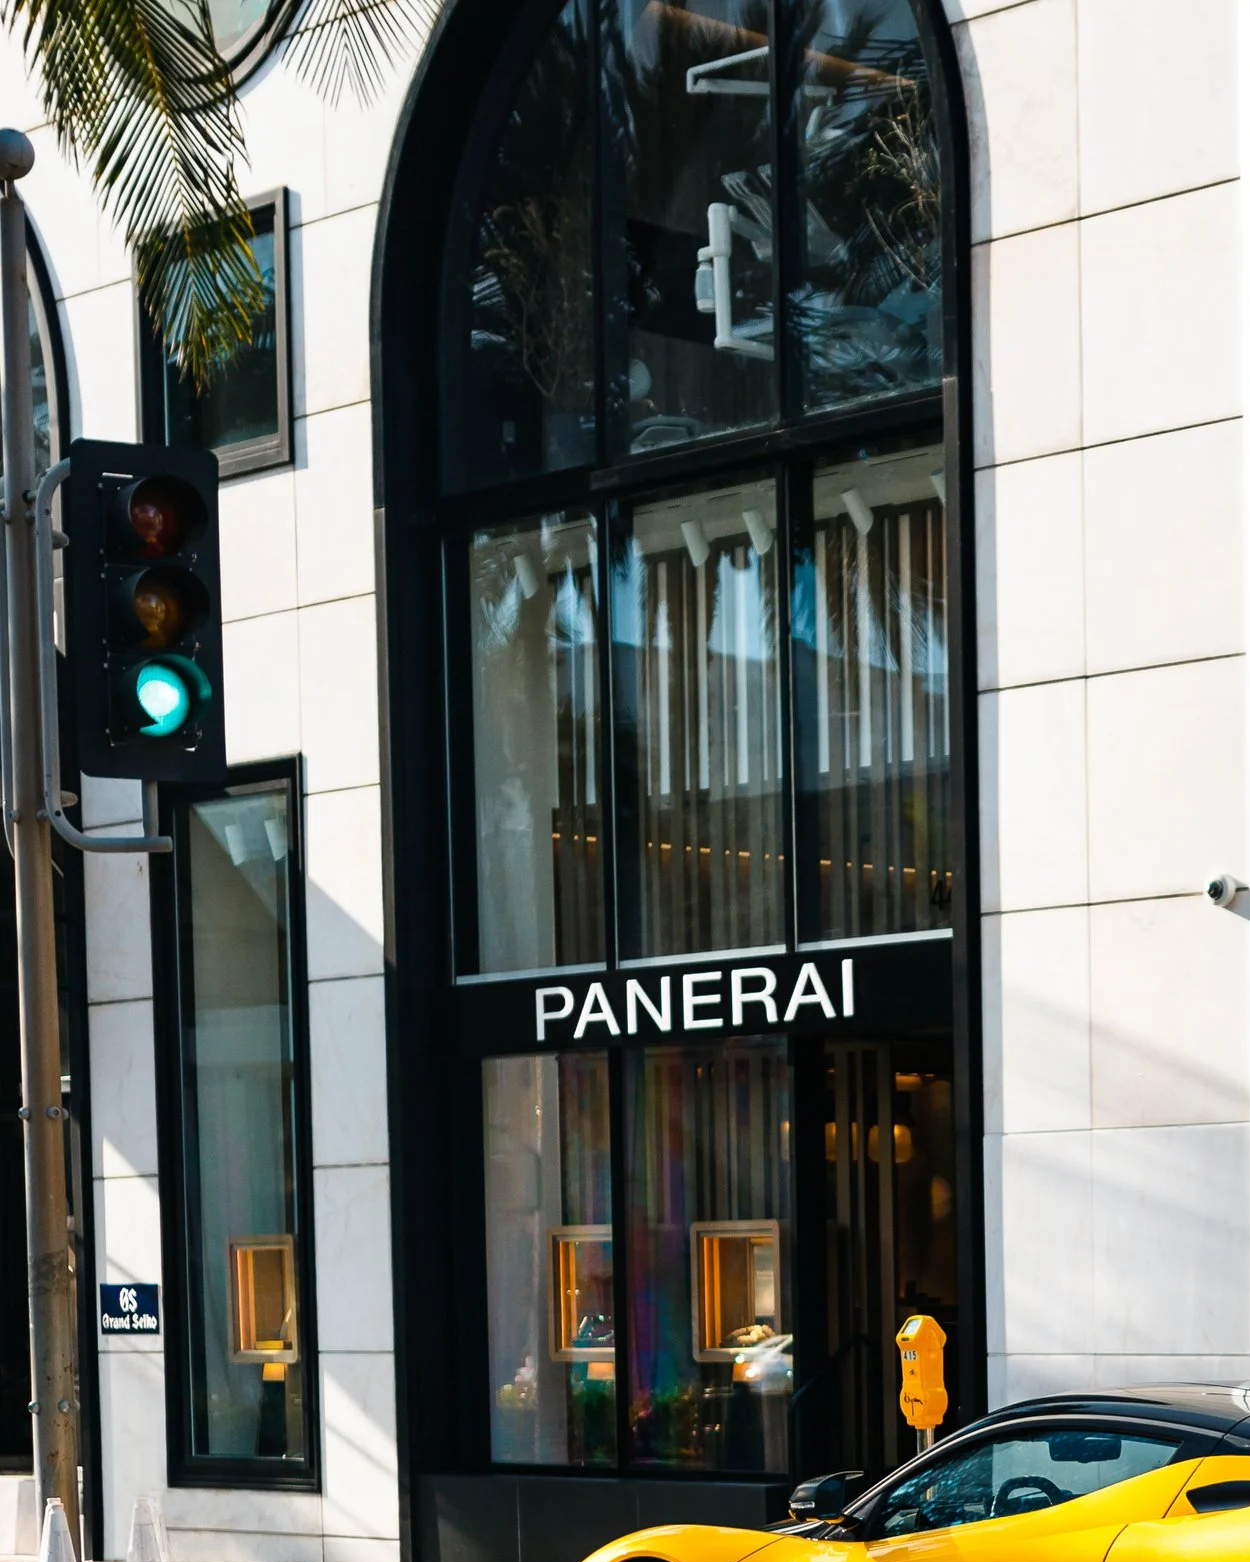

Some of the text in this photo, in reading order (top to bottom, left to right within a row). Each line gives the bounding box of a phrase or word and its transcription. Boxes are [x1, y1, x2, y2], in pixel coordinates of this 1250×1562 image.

[535, 958, 854, 1042] PANERAI
[119, 1287, 138, 1313] GS
[102, 1313, 158, 1330] Grand Seiko
[903, 1350, 917, 1361] 415
